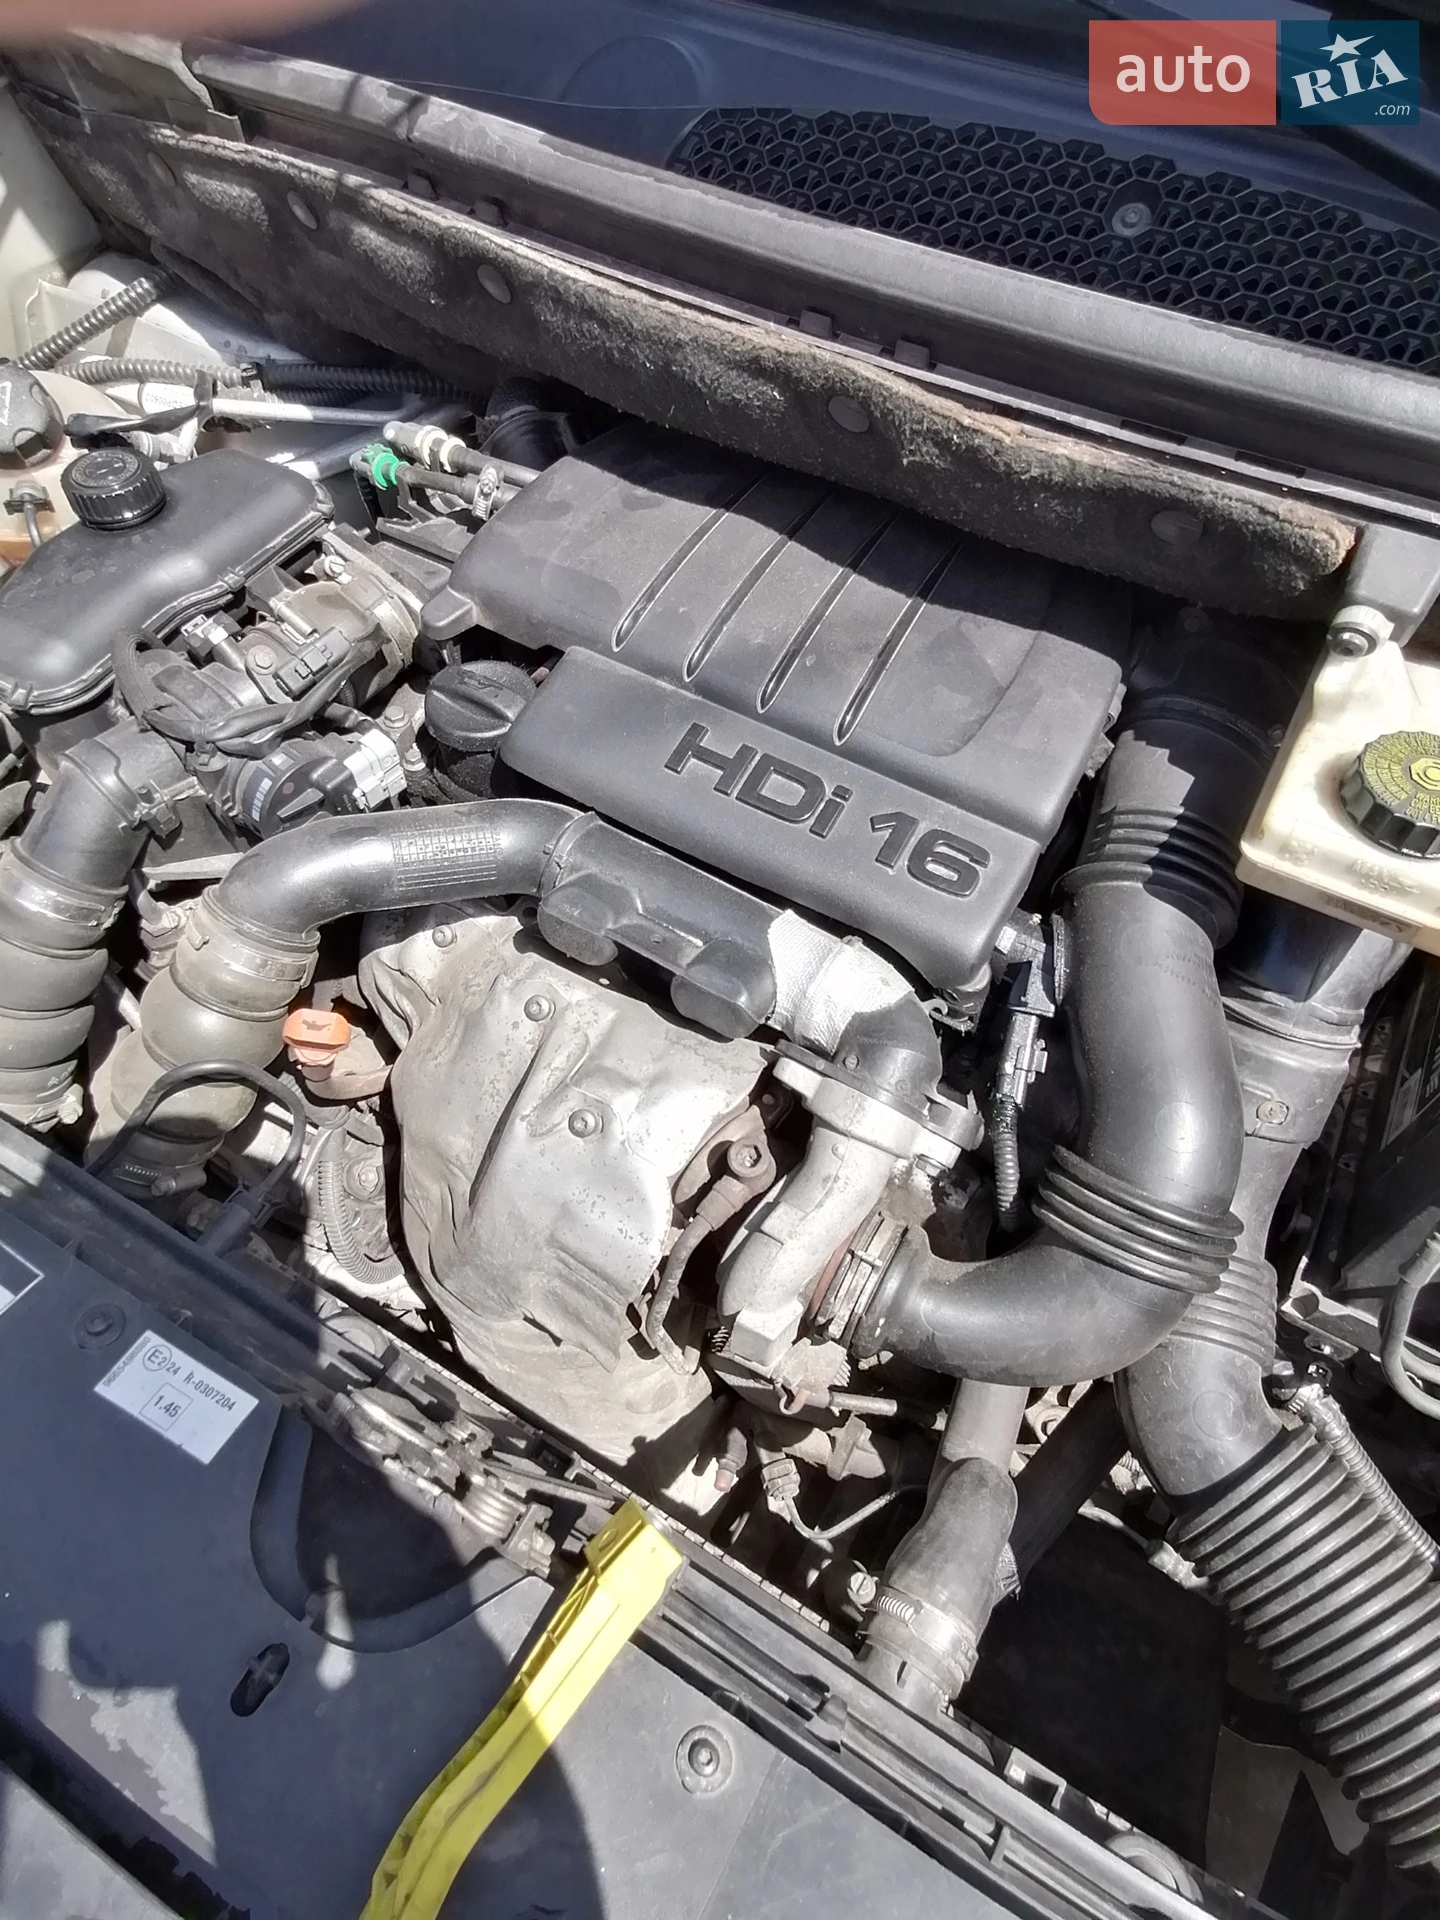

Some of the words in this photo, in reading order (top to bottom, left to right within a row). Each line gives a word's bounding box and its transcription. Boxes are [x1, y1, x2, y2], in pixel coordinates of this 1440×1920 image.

[664, 722, 853, 839] HDi
[869, 811, 992, 898] 16
[154, 1395, 182, 1418] 1.45
[183, 1371, 236, 1411] R-0307204
